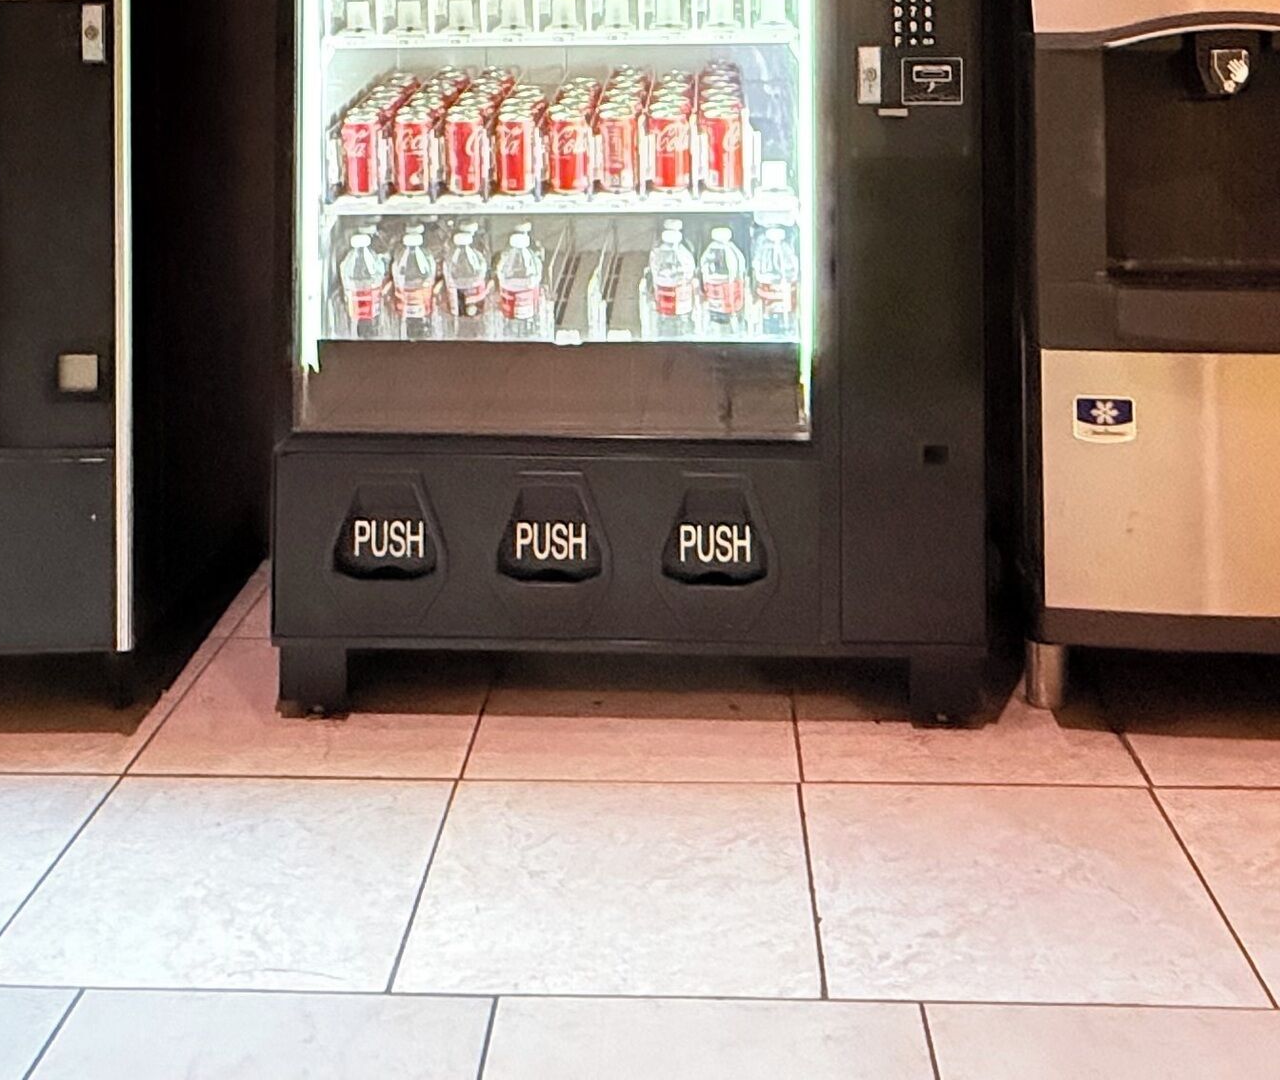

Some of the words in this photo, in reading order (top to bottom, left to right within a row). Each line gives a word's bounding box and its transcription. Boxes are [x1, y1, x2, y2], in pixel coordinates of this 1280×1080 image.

[353, 519, 424, 558] PUSH
[516, 522, 587, 561] PUSH
[679, 524, 751, 563] PUSH
